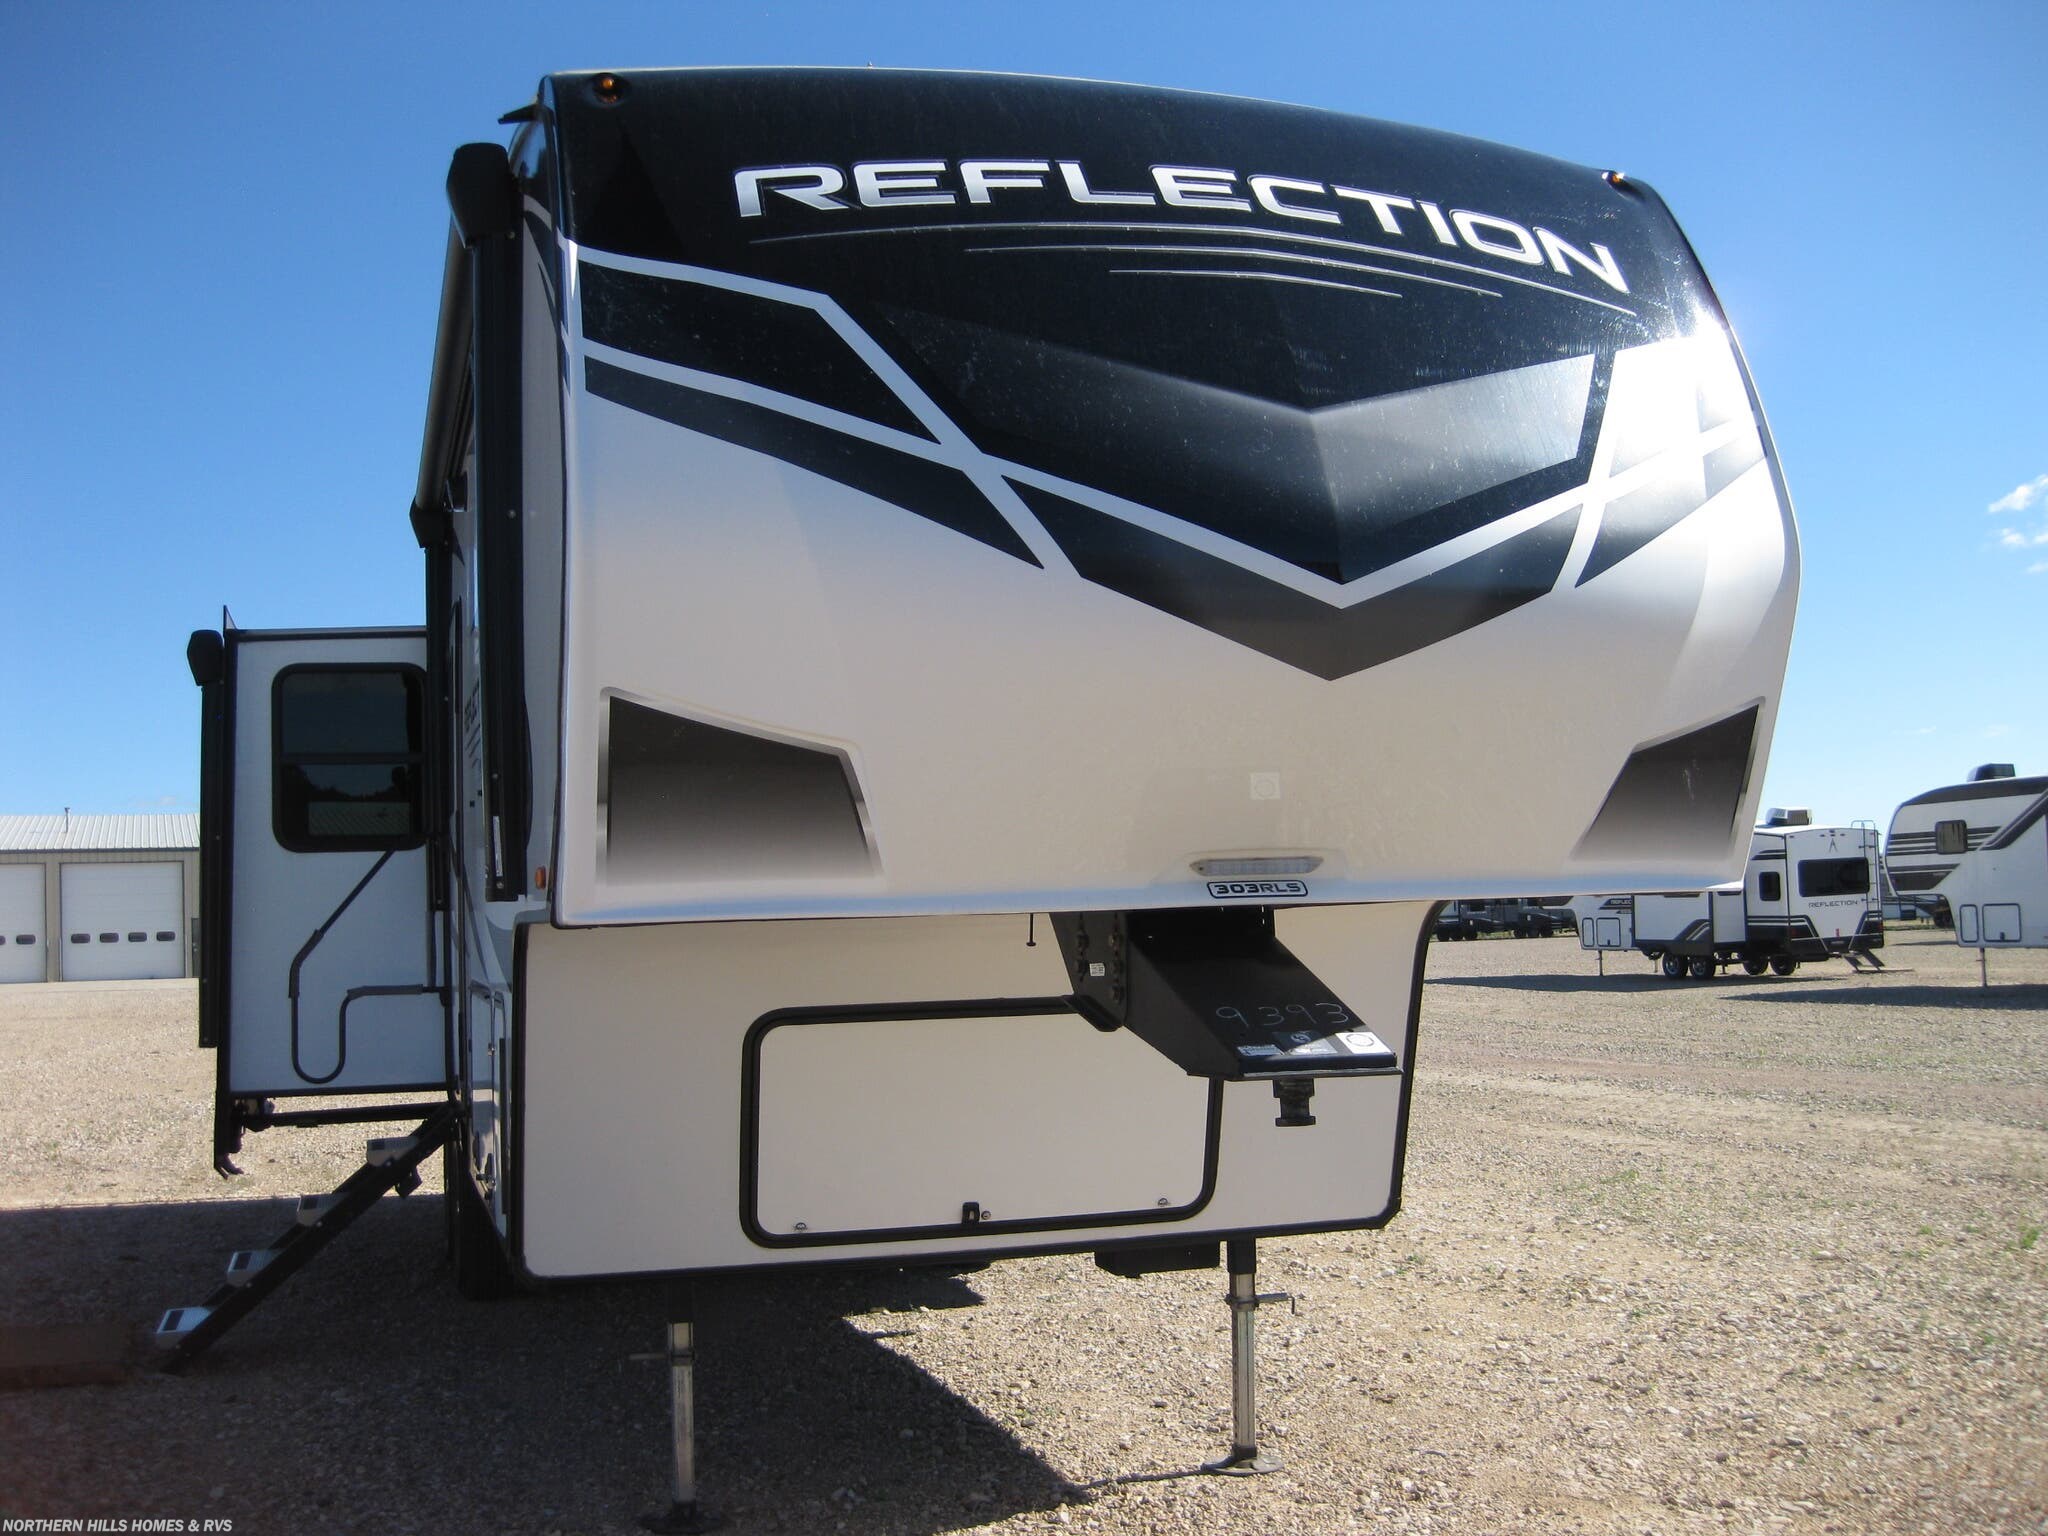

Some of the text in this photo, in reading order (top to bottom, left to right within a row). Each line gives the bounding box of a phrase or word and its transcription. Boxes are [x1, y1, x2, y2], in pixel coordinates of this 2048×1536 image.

[733, 159, 1630, 294] REFLECTION
[1214, 882, 1302, 895] 303RLS
[1808, 899, 1858, 908] REFLECTION
[1215, 1002, 1349, 1028] 9393
